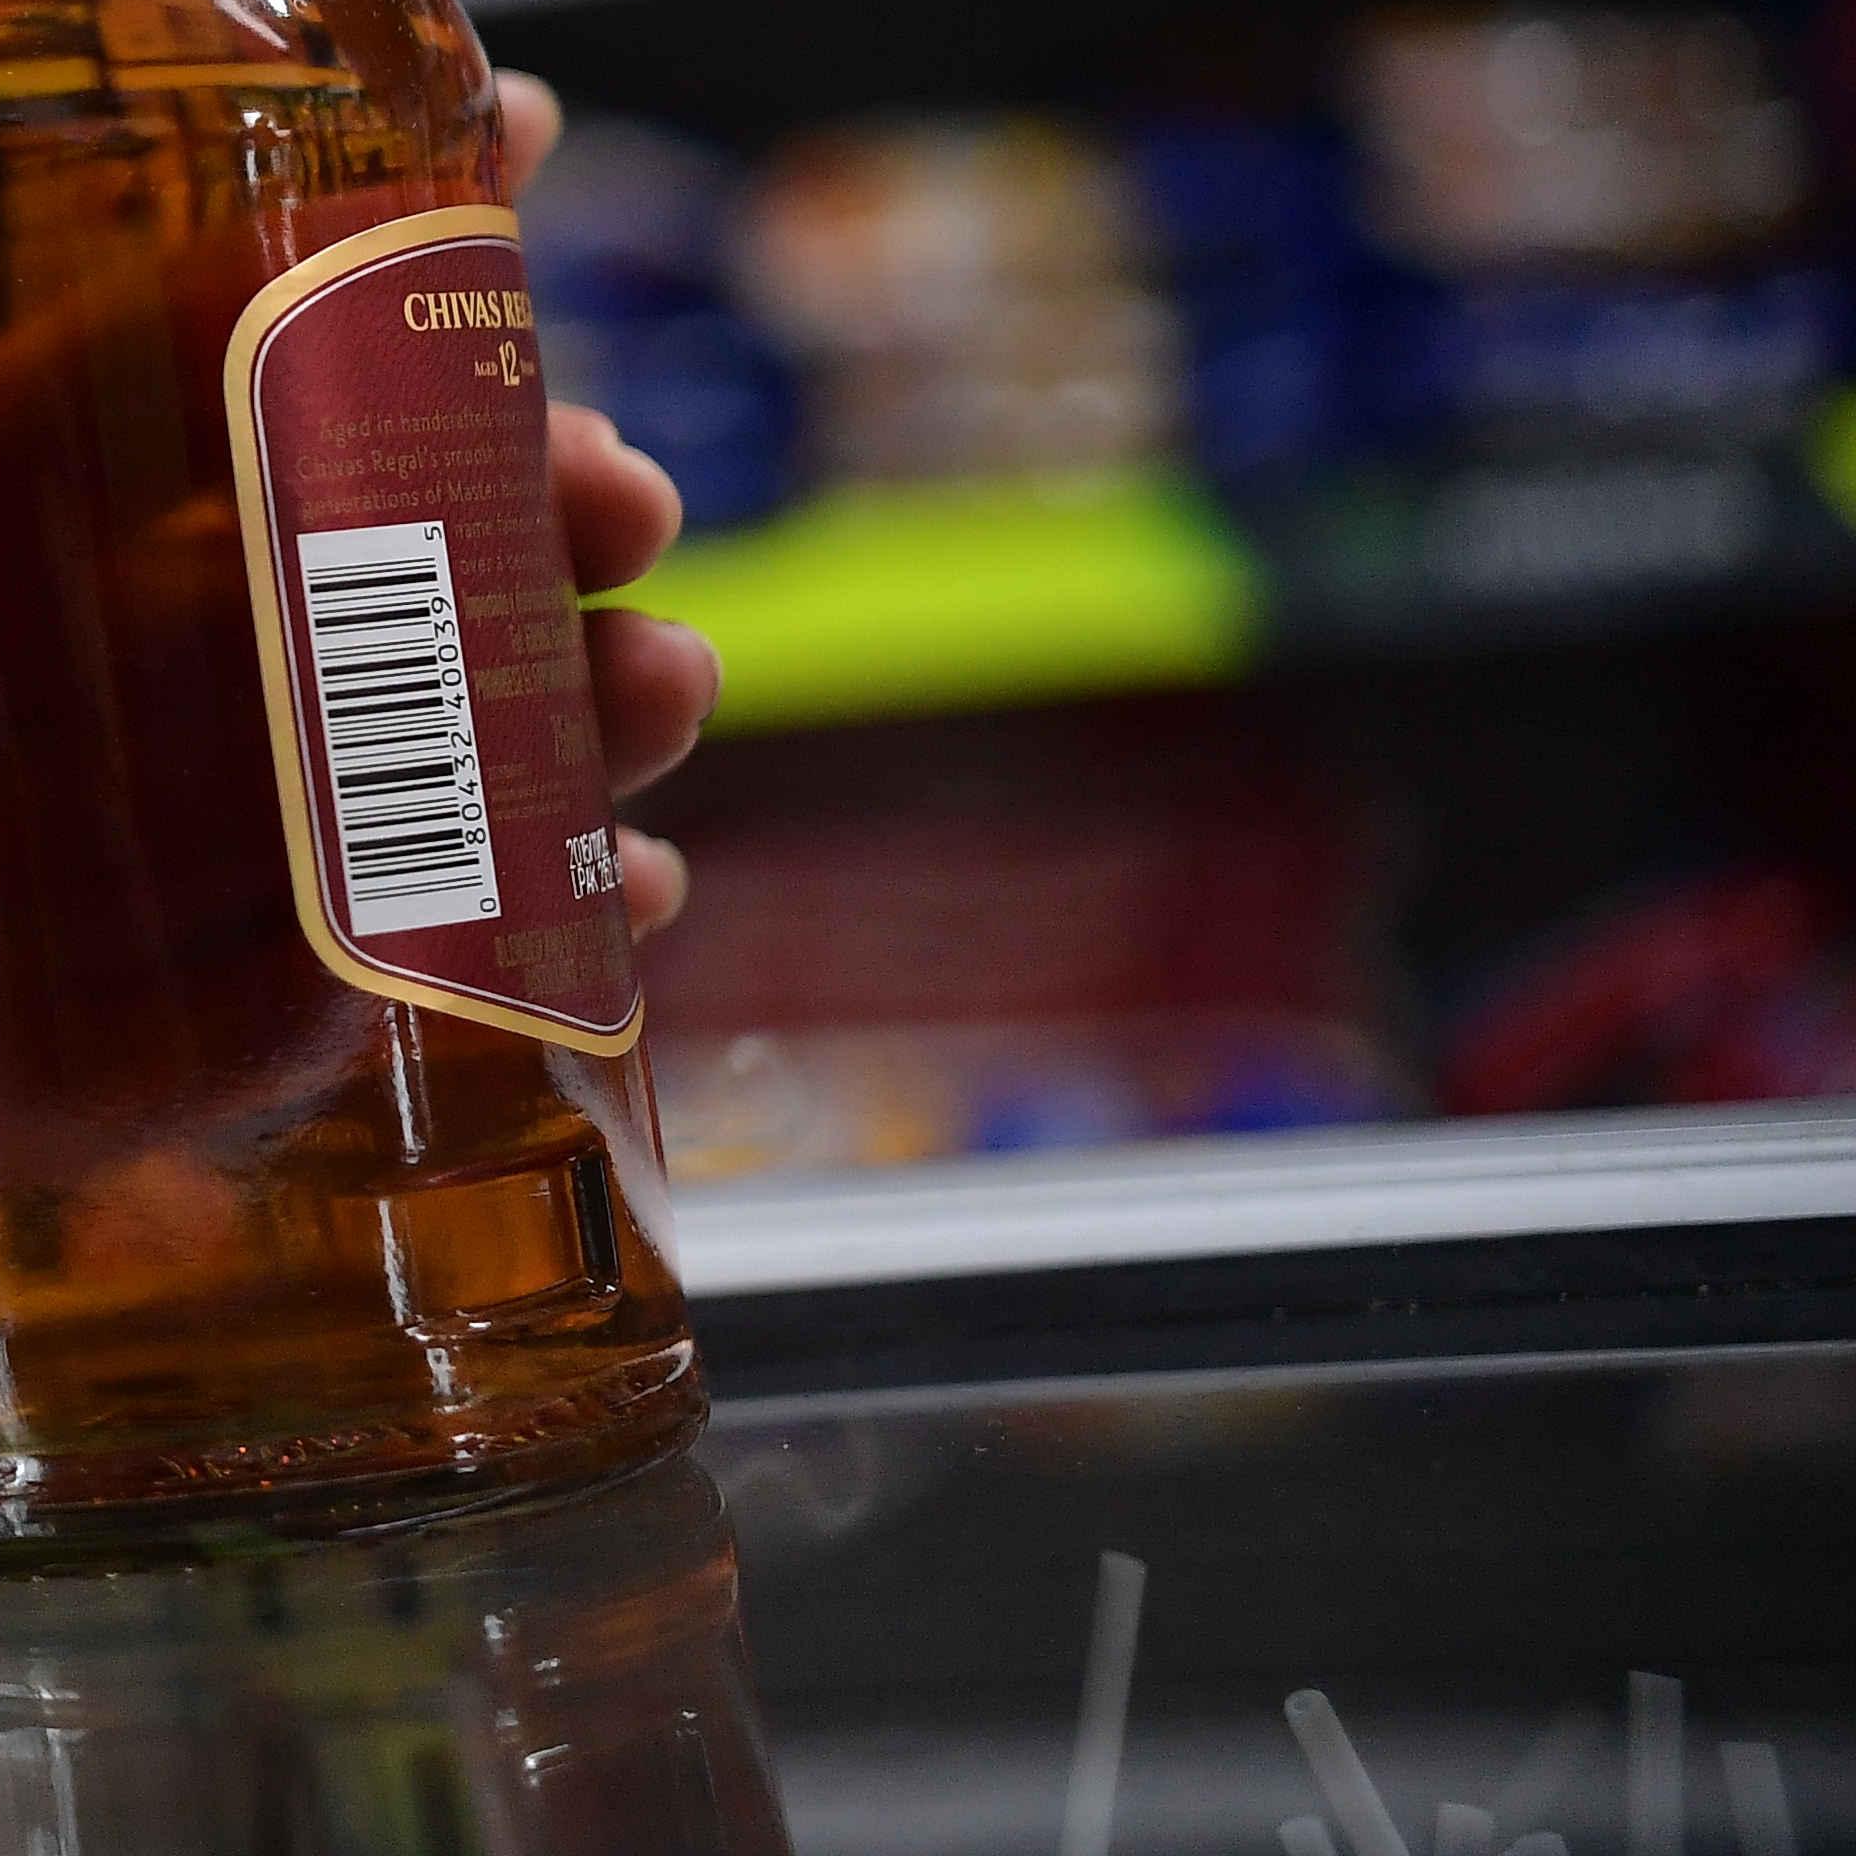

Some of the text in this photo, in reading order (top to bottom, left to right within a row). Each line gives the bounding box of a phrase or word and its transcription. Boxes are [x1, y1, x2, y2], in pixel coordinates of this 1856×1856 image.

[403, 290, 502, 332] CHIVAS
[474, 361, 498, 377] AGED
[499, 340, 520, 387] 12
[376, 412, 395, 434] in
[371, 445, 438, 480] Regal's
[425, 480, 442, 505] of
[423, 526, 497, 913] 0 80432 40039 5
